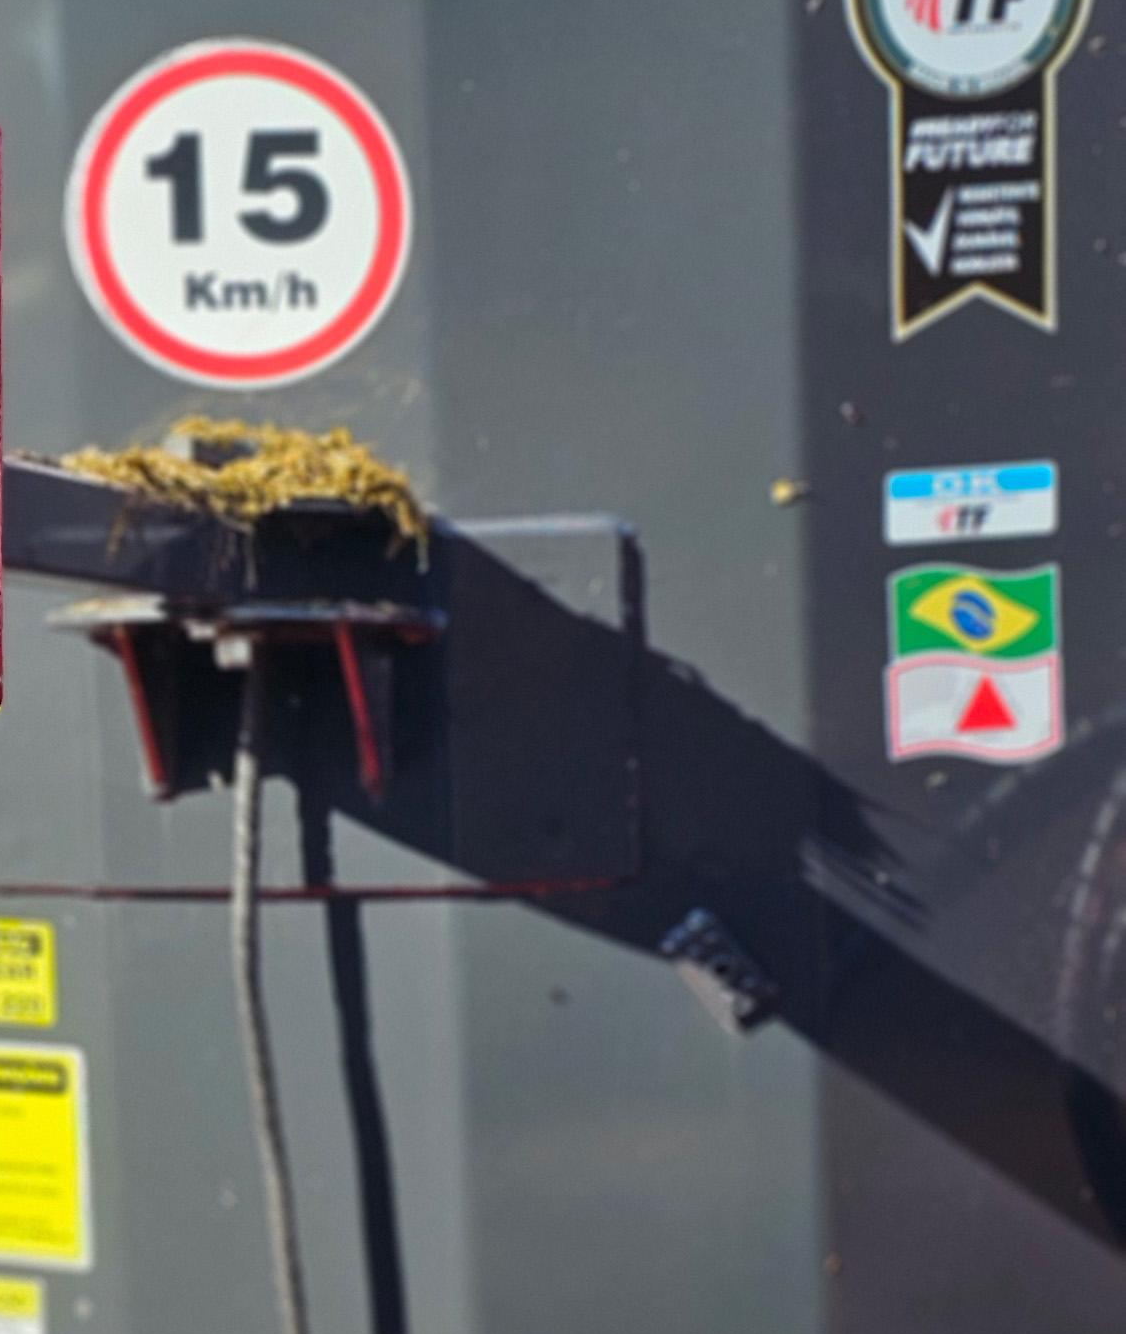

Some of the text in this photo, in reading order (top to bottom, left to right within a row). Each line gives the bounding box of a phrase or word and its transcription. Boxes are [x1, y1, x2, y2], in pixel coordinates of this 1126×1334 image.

[905, 135, 1035, 171] FUTURE
[145, 128, 331, 244] 15
[183, 273, 318, 312] Km/h
